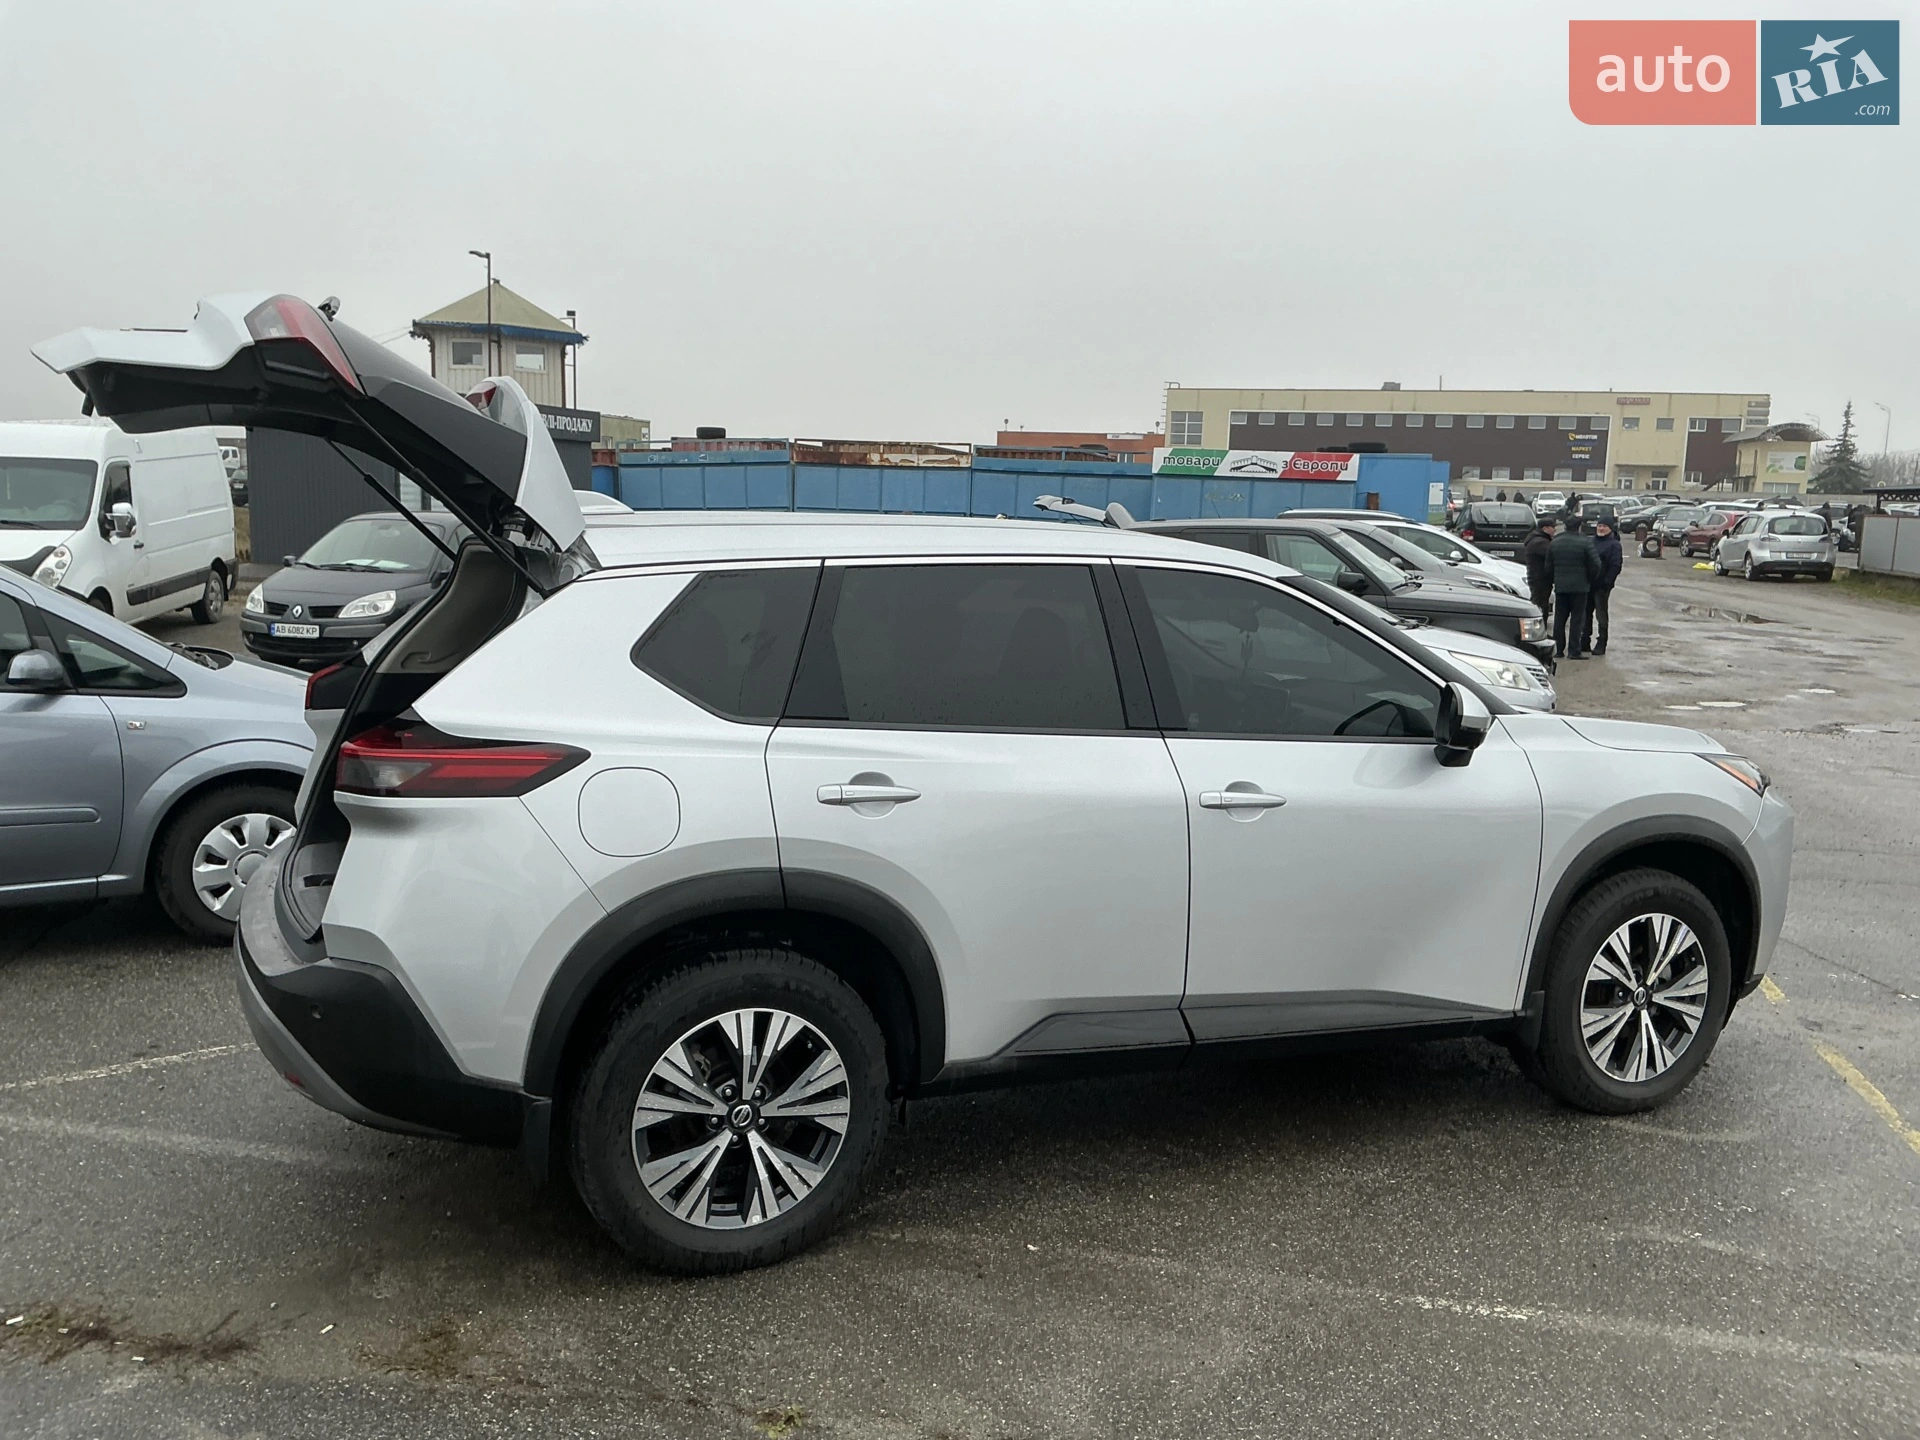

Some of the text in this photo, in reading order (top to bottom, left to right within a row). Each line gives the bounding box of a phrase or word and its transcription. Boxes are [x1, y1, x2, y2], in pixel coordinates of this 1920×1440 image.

[1163, 455, 1350, 473] товари з Європи
